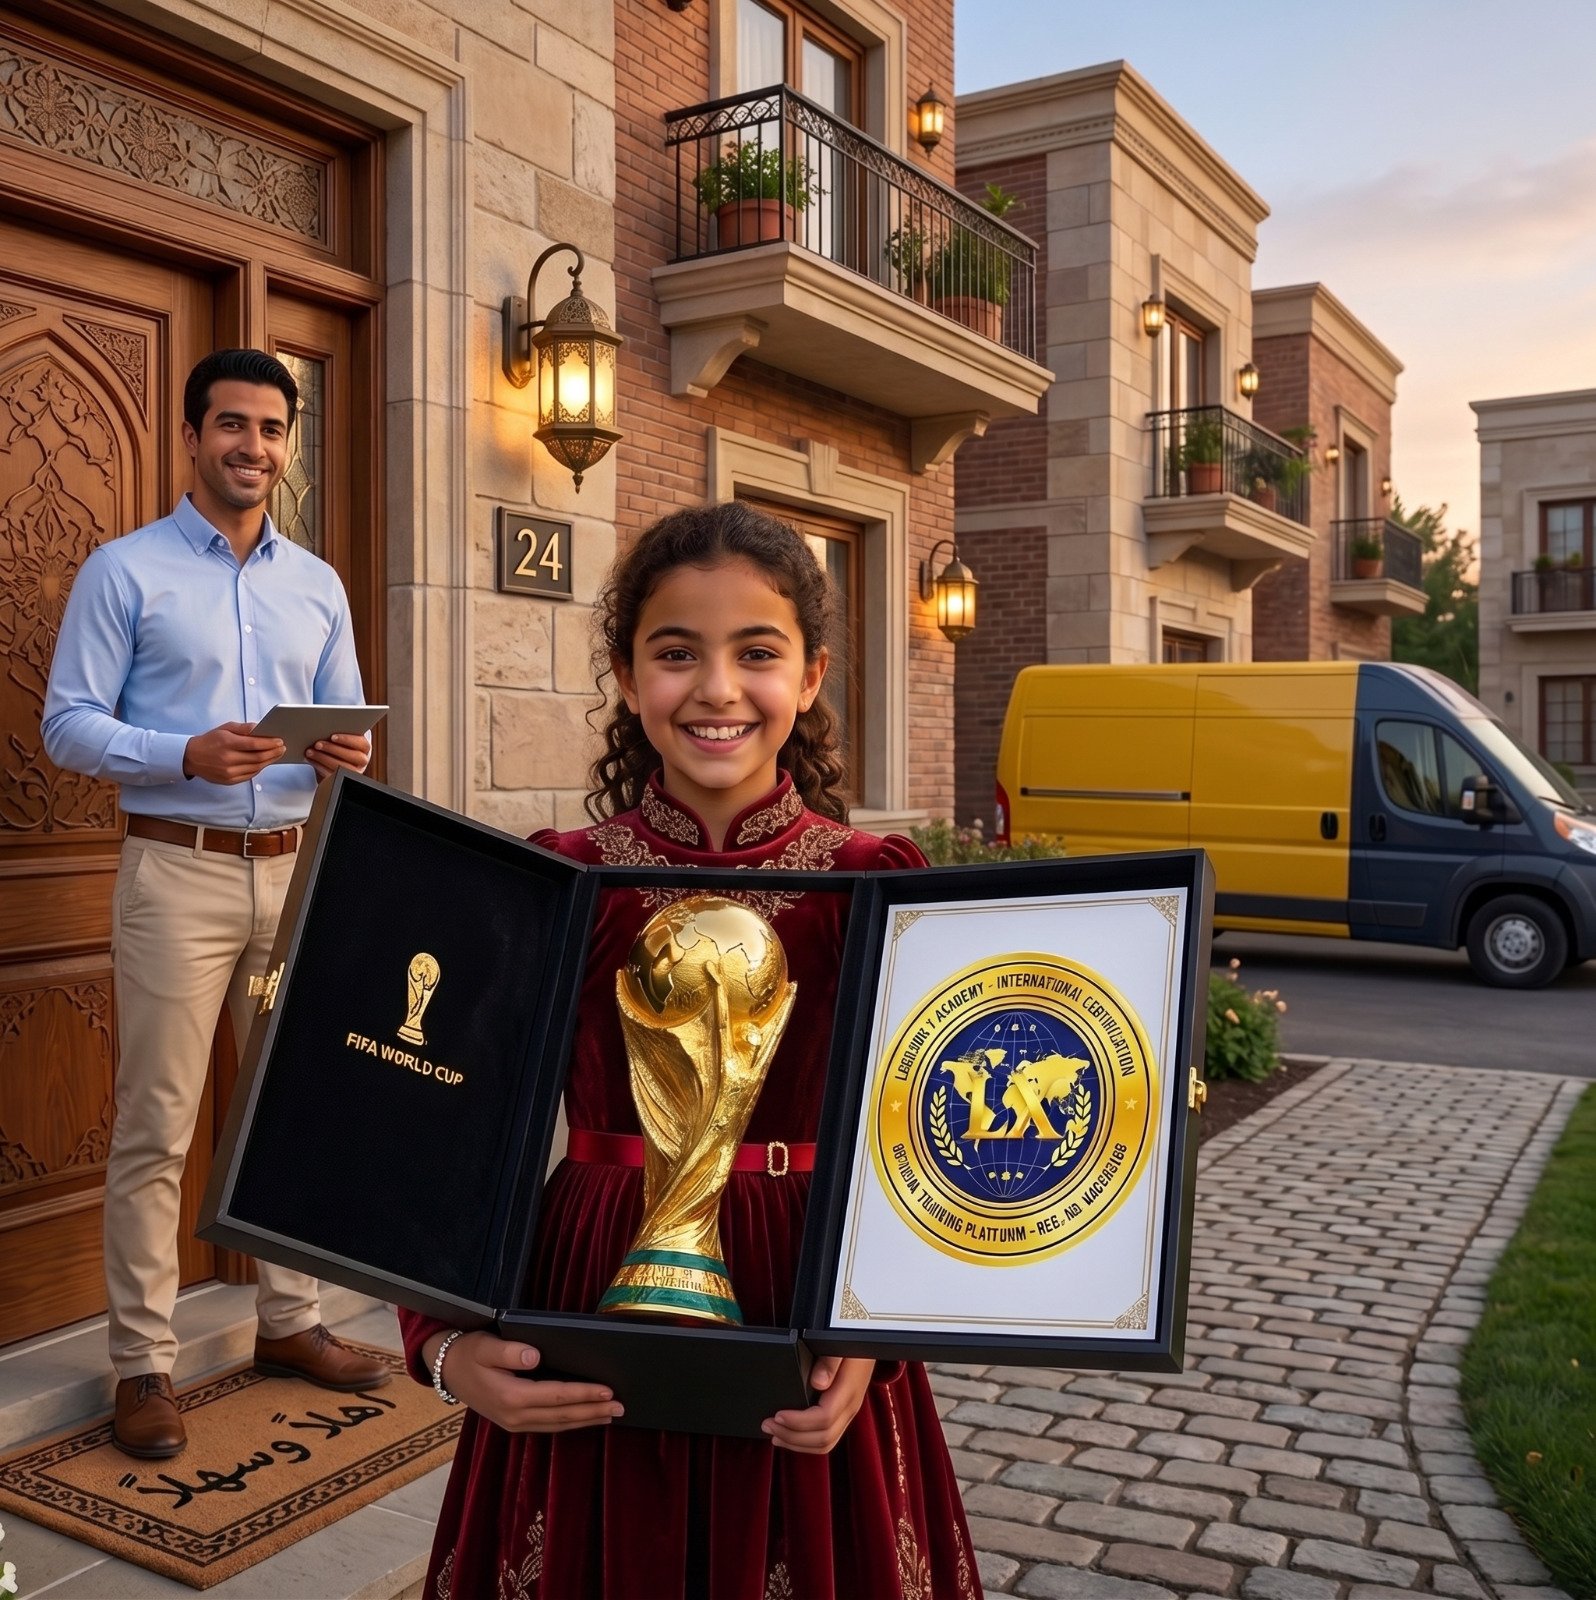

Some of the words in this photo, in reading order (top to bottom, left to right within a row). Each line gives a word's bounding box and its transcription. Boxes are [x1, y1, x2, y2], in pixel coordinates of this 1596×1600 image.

[514, 528, 563, 581] 24
[935, 982, 984, 1022] ACADEMY
[346, 1032, 378, 1057] FIFA
[381, 1044, 433, 1076] WORLD
[435, 1066, 464, 1086] CUP
